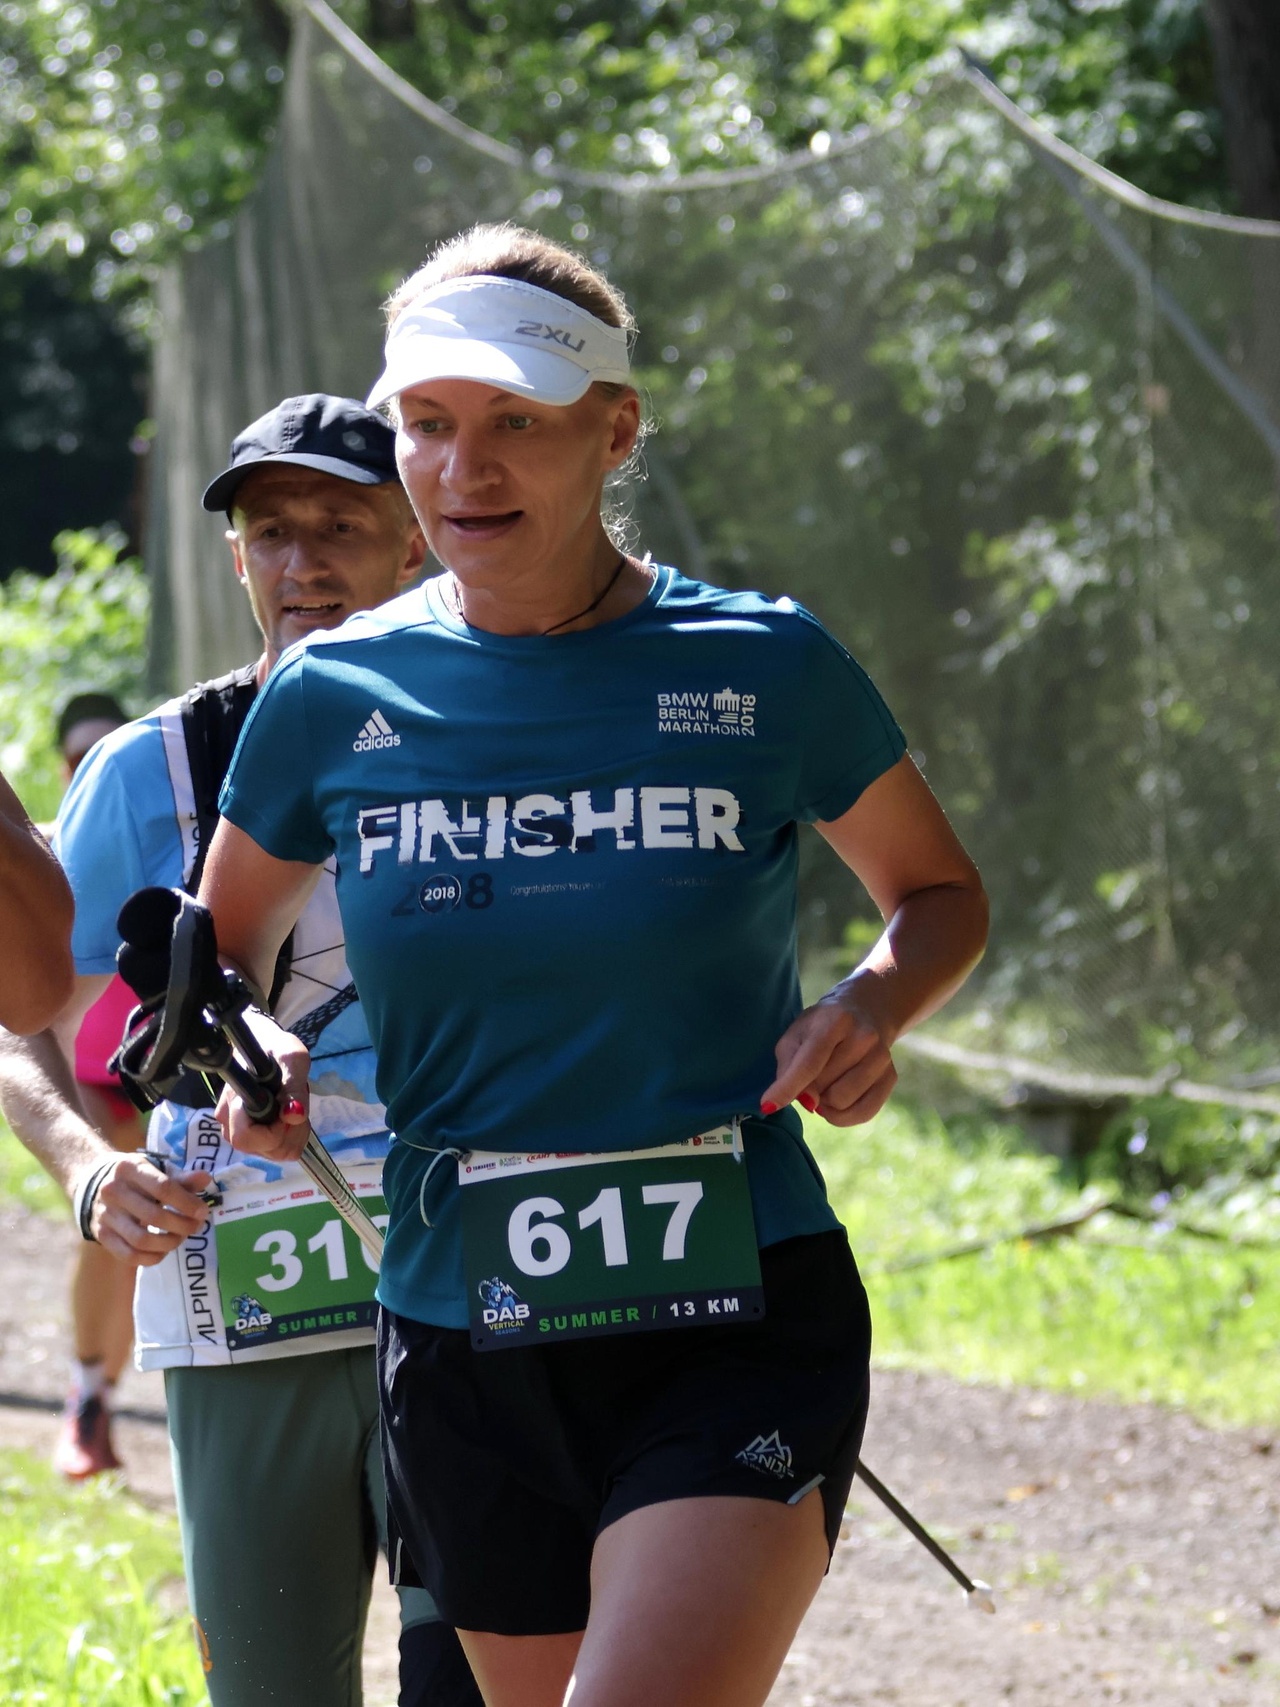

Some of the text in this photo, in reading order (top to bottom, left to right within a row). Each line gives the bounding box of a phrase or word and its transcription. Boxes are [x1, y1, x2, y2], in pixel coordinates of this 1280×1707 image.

[515, 320, 586, 353] 2XU
[658, 692, 708, 708] BMW
[659, 708, 709, 721] BERLIN
[741, 694, 756, 736] 2018
[659, 721, 740, 736] MARATHON
[353, 733, 401, 752] adidas
[357, 787, 745, 873] FINISHER
[424, 886, 455, 901] 2018
[191, 1113, 221, 1172] ELBR
[508, 1182, 703, 1276] 617
[235, 1313, 272, 1331] DAB
[278, 1311, 357, 1334] SUMMER
[483, 1304, 530, 1324] DAB
[539, 1307, 640, 1332] SUMMER
[670, 1301, 696, 1317] 13
[707, 1298, 740, 1315] KM
[489, 1320, 525, 1330] VERTICAL
